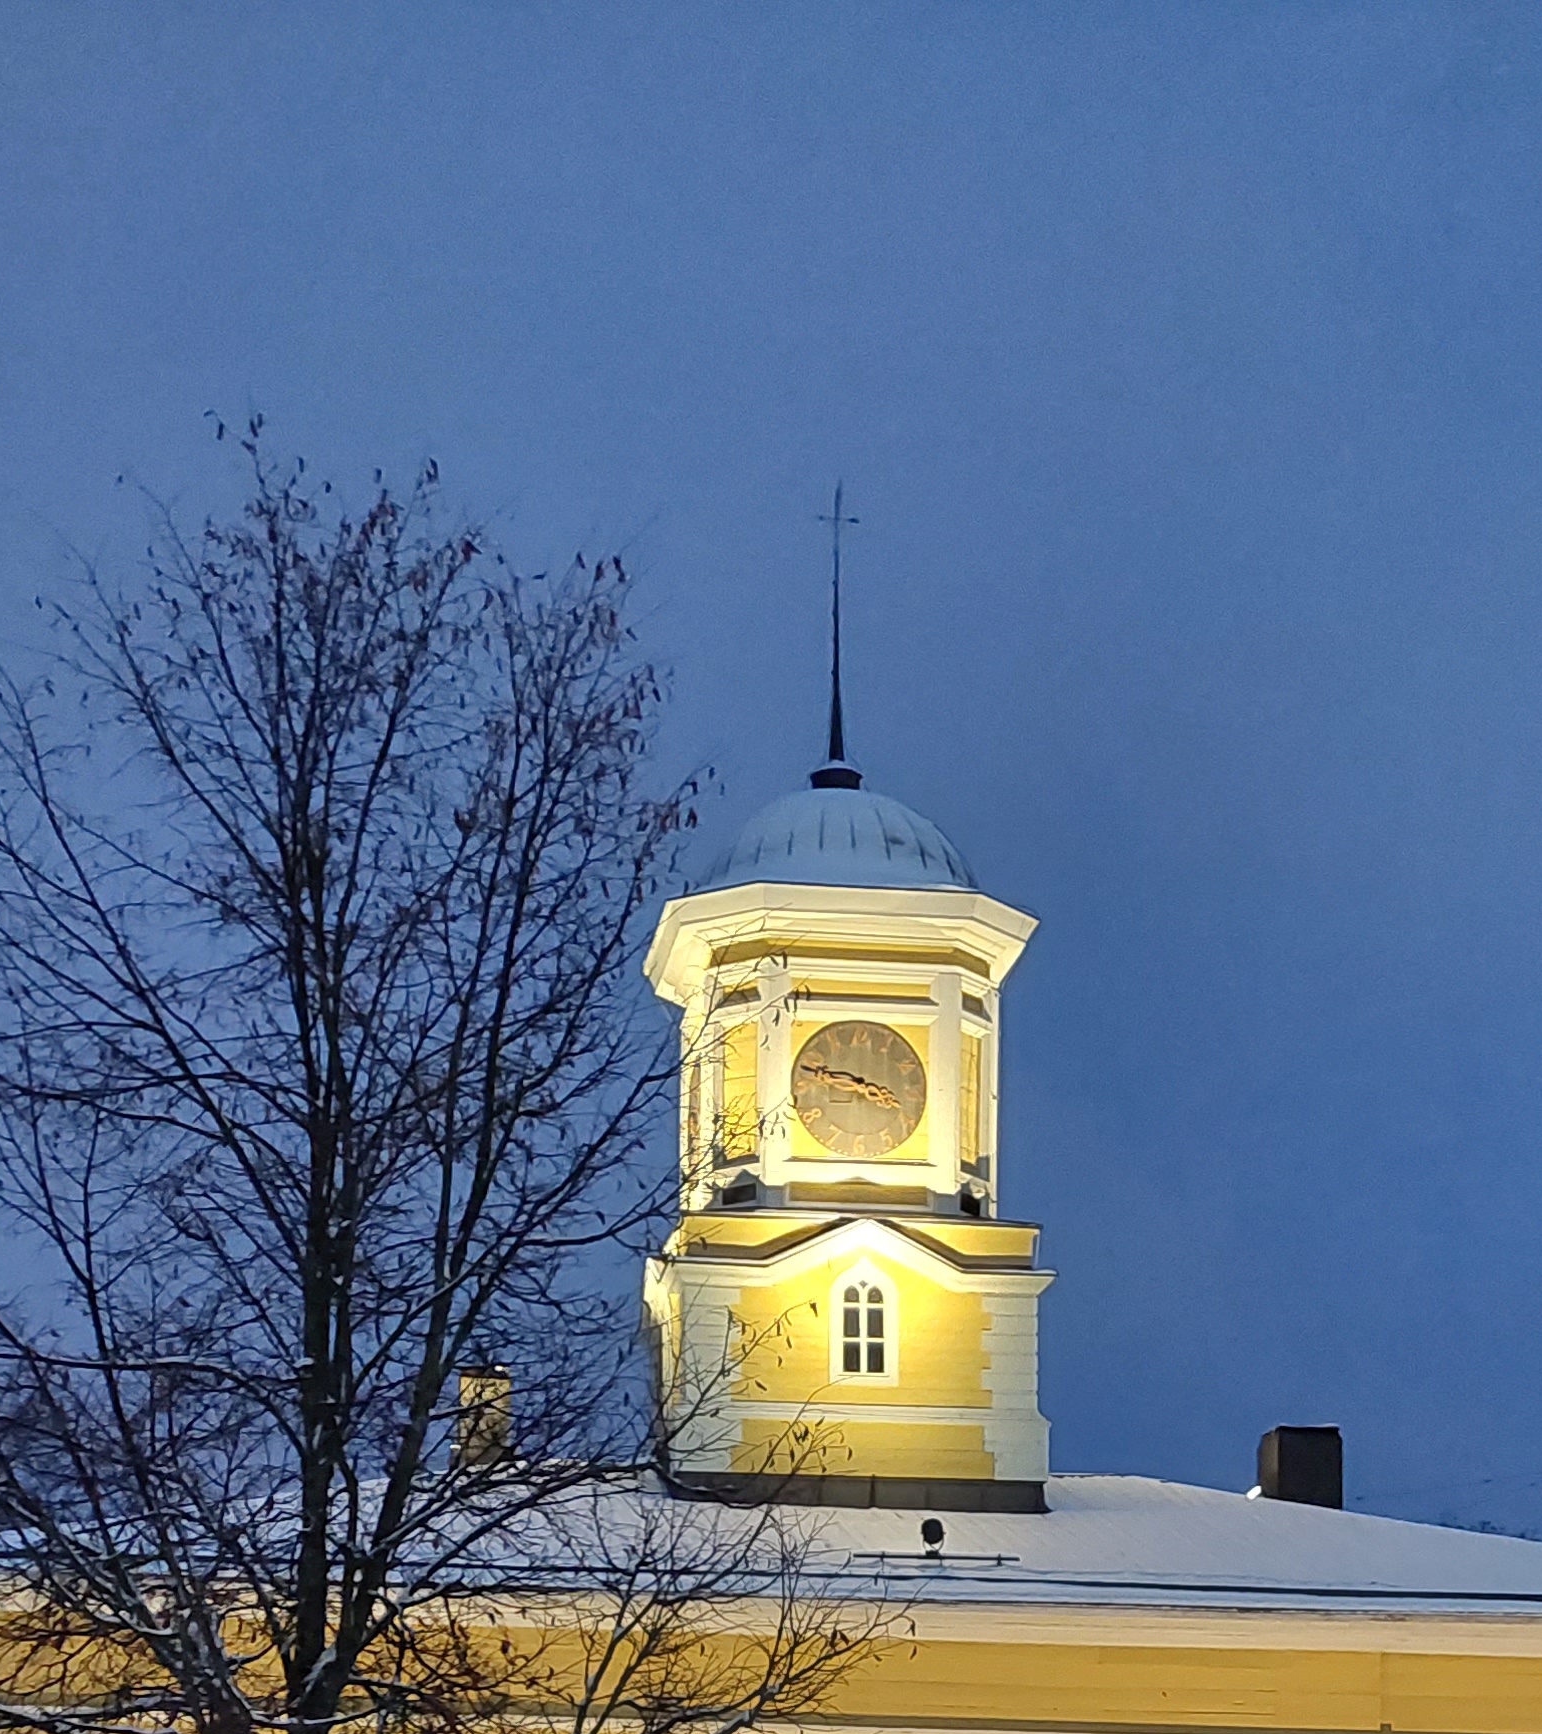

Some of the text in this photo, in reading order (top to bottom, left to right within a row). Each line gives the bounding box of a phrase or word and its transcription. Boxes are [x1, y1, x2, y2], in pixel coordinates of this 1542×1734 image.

[802, 1108, 822, 1124] 8
[825, 1124, 842, 1146] 7
[853, 1135, 865, 1154] 6
[879, 1128, 893, 1151] 5
